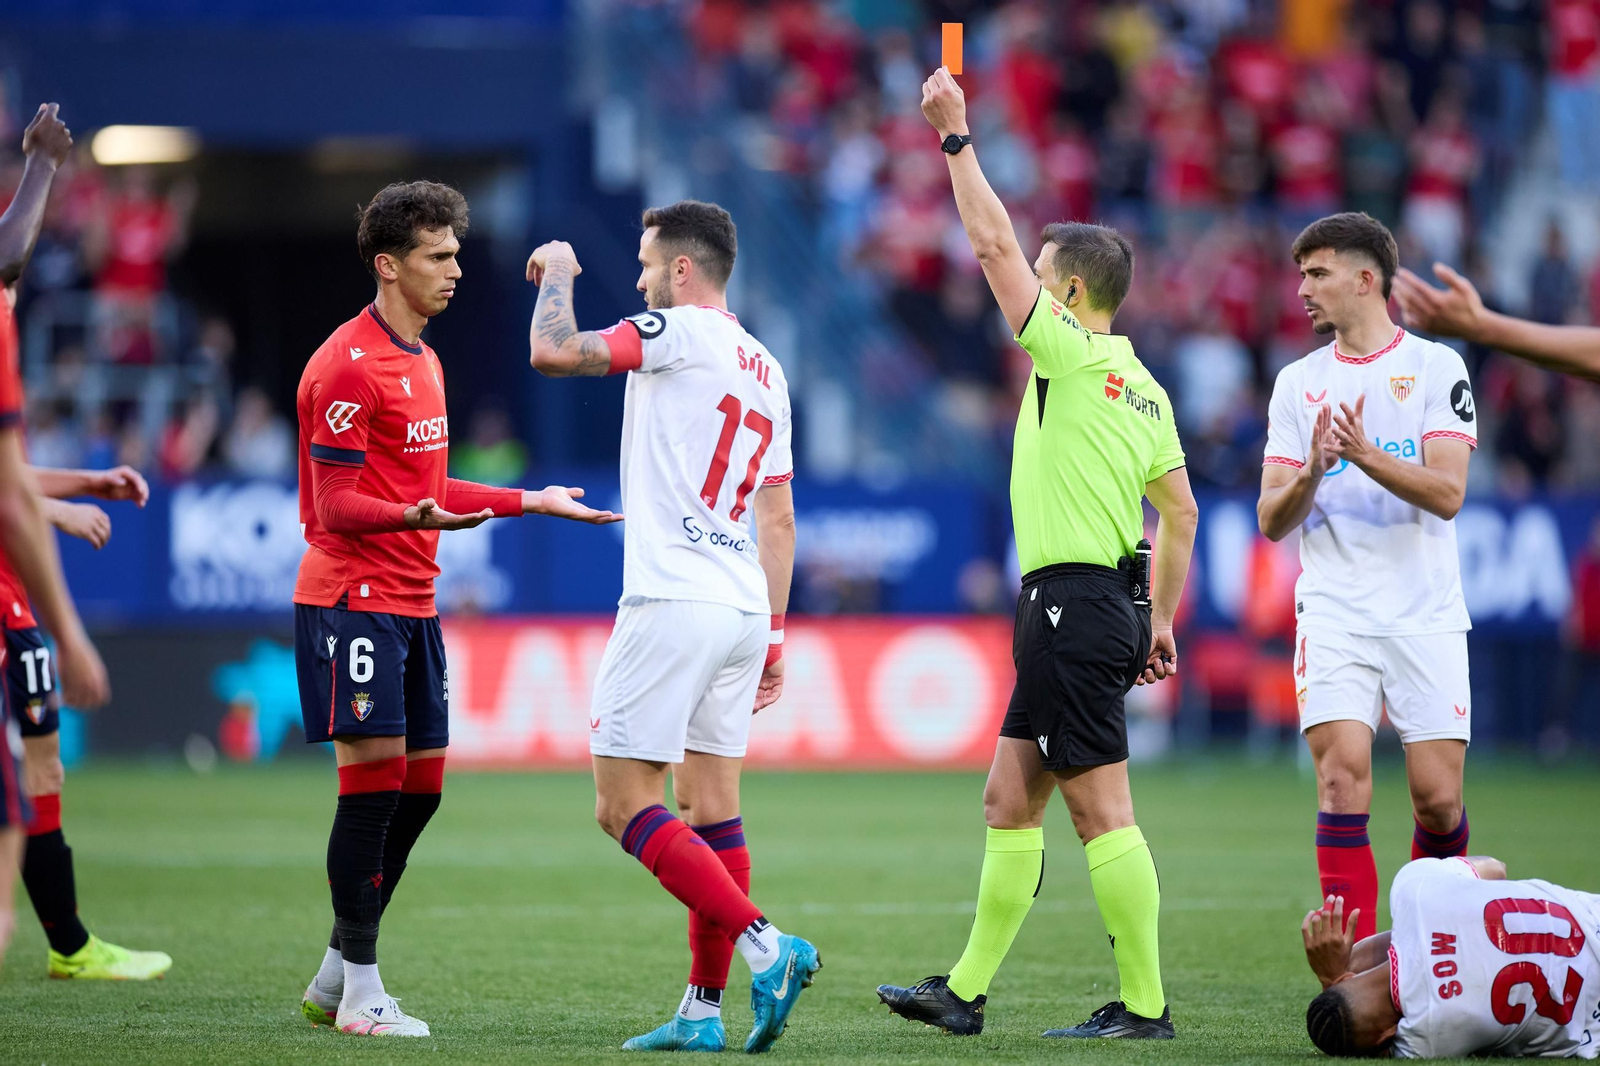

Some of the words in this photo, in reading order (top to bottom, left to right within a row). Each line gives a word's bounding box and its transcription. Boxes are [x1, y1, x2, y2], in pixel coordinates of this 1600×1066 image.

[1455, 388, 1474, 414] JD
[699, 393, 773, 522] 17
[20, 647, 52, 694] 17
[349, 637, 374, 683] 6
[1297, 636, 1307, 678] 4
[1431, 932, 1463, 999] SOW
[1483, 897, 1586, 1026] 20
